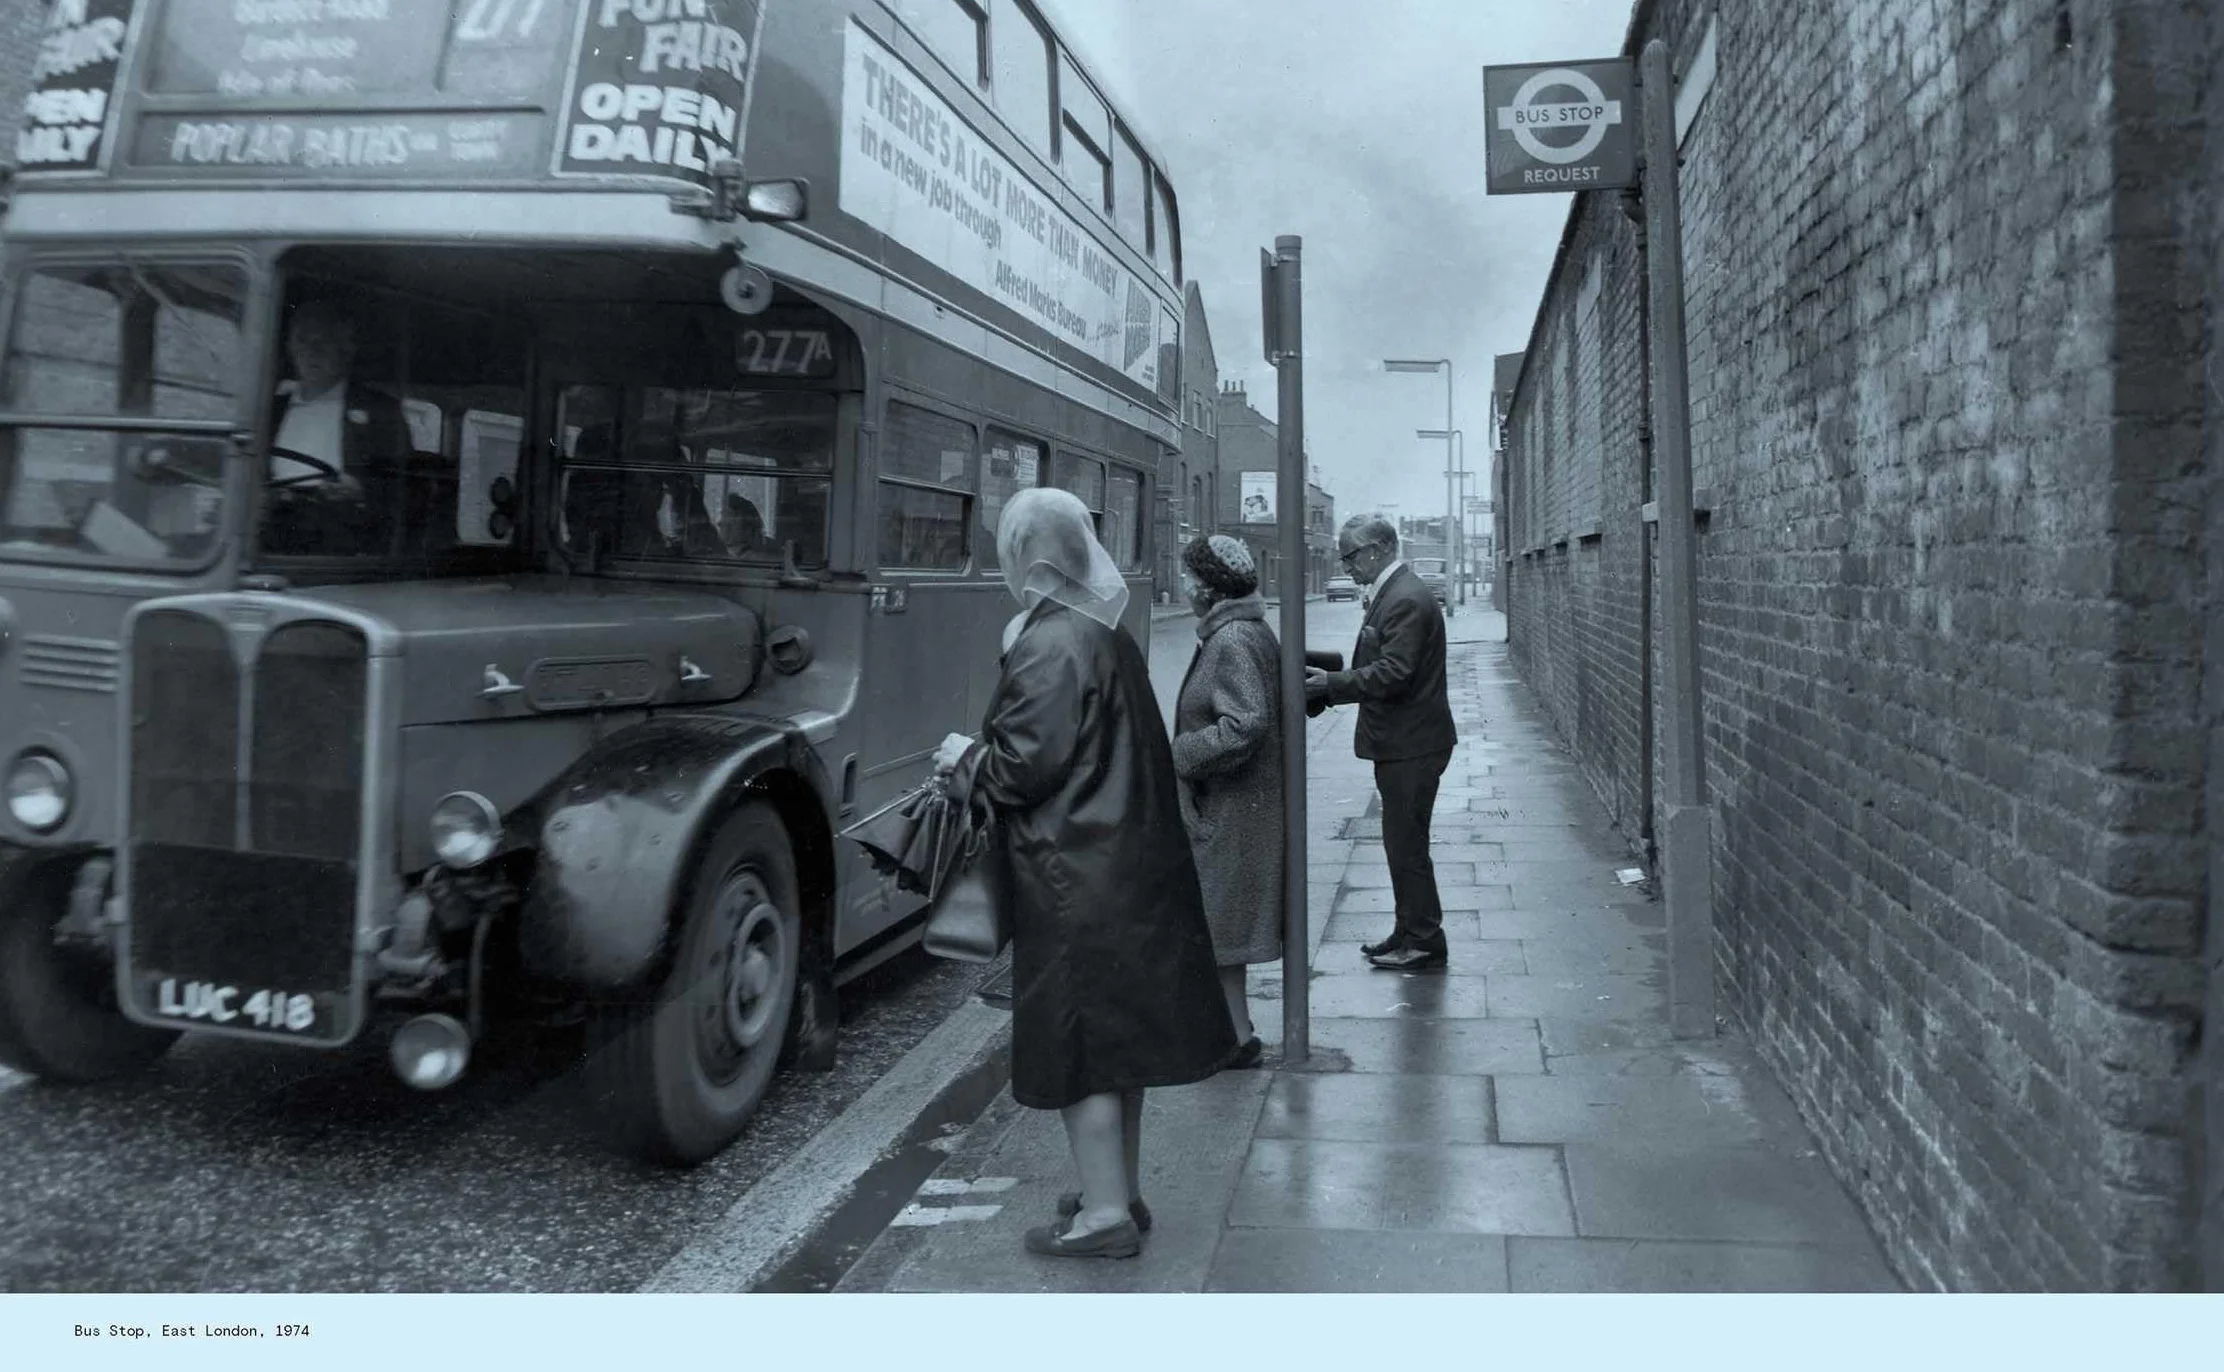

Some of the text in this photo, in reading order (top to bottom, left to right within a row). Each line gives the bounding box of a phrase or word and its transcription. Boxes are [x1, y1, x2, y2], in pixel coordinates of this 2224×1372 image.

[639, 20, 748, 83] FAIR
[580, 82, 737, 143] OPEN
[1515, 106, 1605, 124] BUS STOP
[170, 122, 294, 164] POPLAR
[569, 123, 733, 177] DAILY
[860, 114, 1002, 252] in a new job through
[862, 52, 951, 168] THERE'S
[954, 134, 967, 183] A
[971, 147, 1003, 210] LOT
[1005, 176, 1046, 245] MORE
[1049, 213, 1080, 271] THAN
[1082, 245, 1118, 299] MONEY
[1524, 166, 1601, 184] REQUEST
[995, 259, 1028, 305] Alfred
[1028, 280, 1057, 325] Marks
[1056, 301, 1088, 342] Bureau
[743, 329, 833, 373] 277A
[158, 978, 315, 1031] LUC 418
